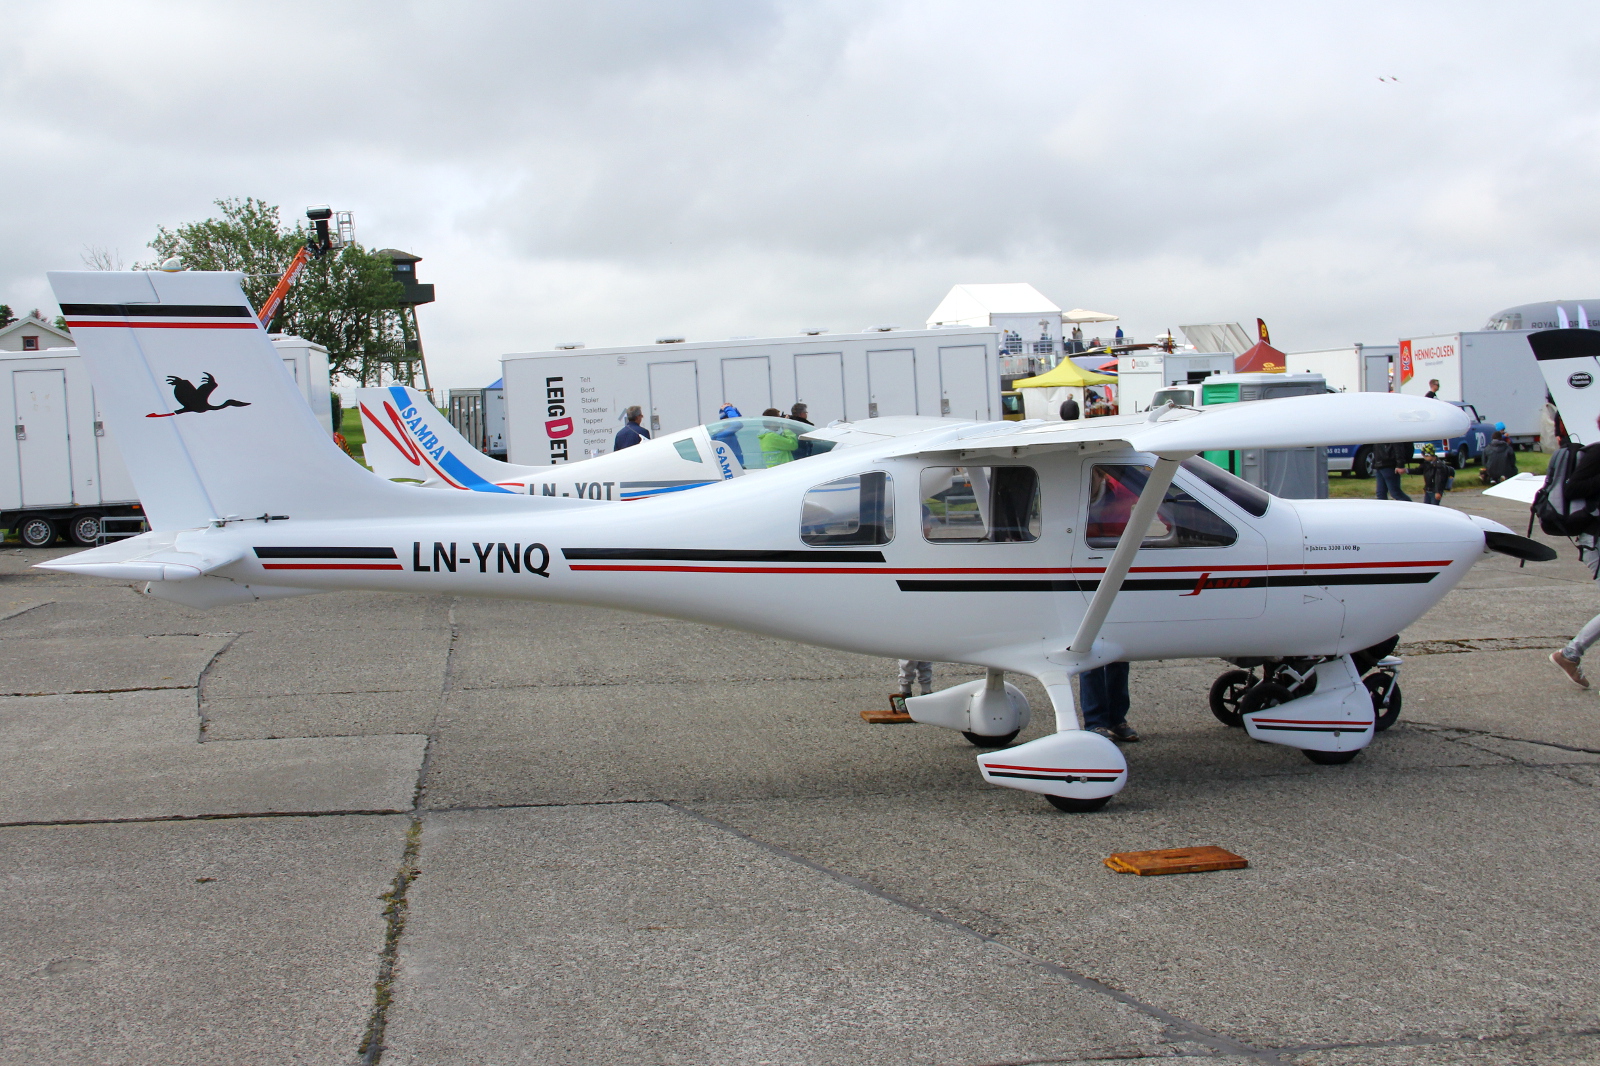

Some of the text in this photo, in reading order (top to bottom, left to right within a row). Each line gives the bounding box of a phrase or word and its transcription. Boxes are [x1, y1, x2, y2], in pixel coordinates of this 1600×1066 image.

[1531, 321, 1559, 329] ROYAL
[1414, 345, 1454, 360] HENNIG-OLSEN
[402, 407, 444, 461] SAMBA
[413, 541, 550, 578] LN-YNQ
